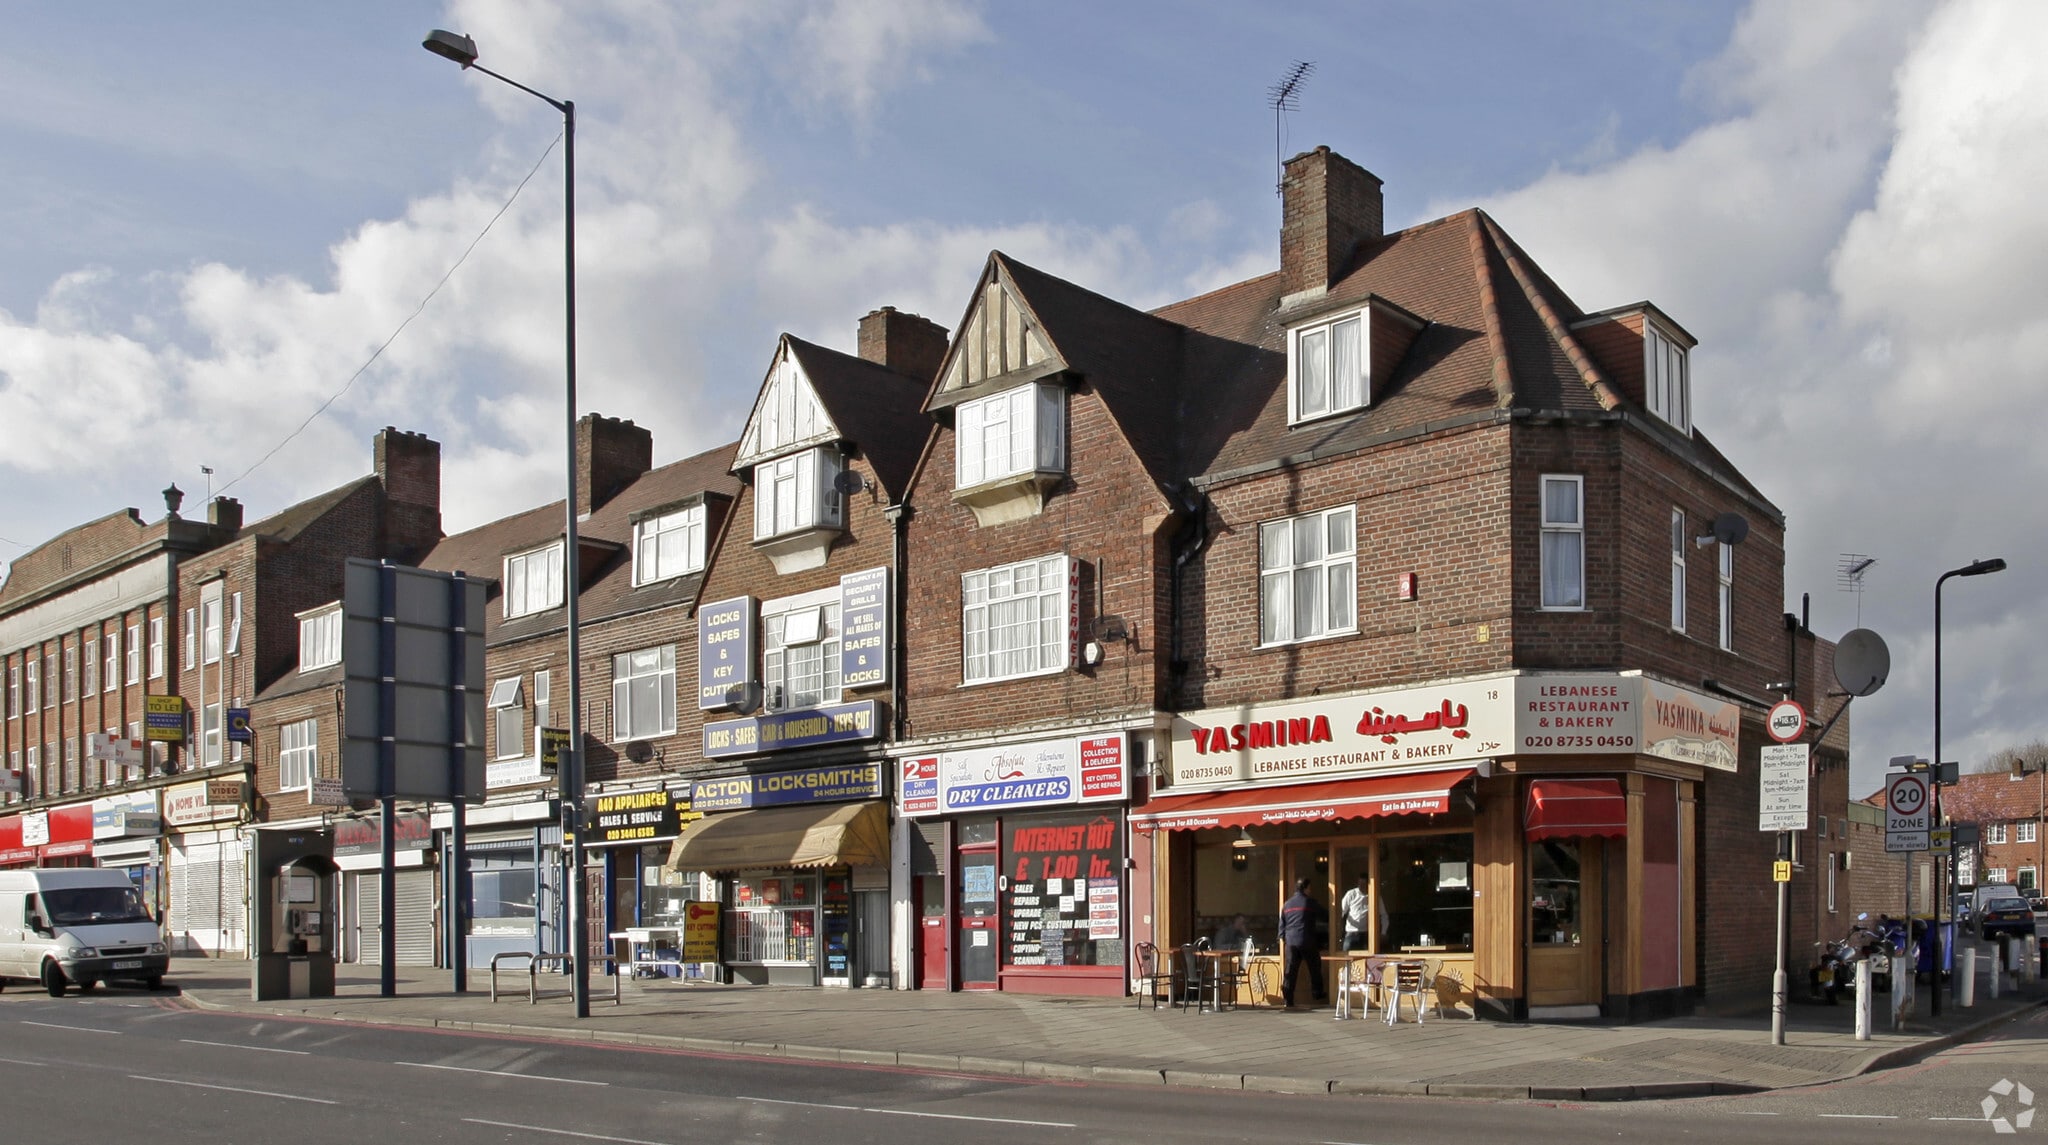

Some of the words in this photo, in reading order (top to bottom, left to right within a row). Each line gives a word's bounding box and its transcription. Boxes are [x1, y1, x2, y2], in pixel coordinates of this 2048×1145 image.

[845, 581, 882, 596] SECURITY
[850, 594, 876, 606] GRILLS
[707, 610, 740, 627] LOCKS
[853, 615, 862, 625] WE
[862, 613, 874, 623] SELL
[1069, 562, 1079, 666] INTERNET
[846, 626, 855, 635] ALL
[855, 622, 874, 633] MAKES
[874, 621, 882, 630] OF
[707, 628, 740, 644] SAFES
[845, 636, 881, 651] SAFES
[720, 649, 727, 660] &
[858, 655, 866, 665] &
[713, 665, 733, 679] KEY
[844, 669, 881, 684] LOCKS
[703, 681, 743, 698] CUTTING
[1487, 690, 1498, 700] 18
[1540, 686, 1618, 696] LEBANESE
[1528, 701, 1630, 712] RESTAURANT
[1539, 717, 1550, 727] &
[1555, 716, 1614, 727] BAKERY
[1656, 700, 1705, 735] YASMINA
[708, 730, 729, 749] LOCKS
[735, 726, 756, 745] SAFES
[762, 724, 776, 742] CAR
[777, 725, 783, 740] &
[784, 717, 828, 739] HOUSEHOLD
[834, 713, 853, 733] KEYS
[855, 710, 871, 730] CUT
[1191, 714, 1334, 756] YASMINA
[1092, 739, 1108, 747] FREE
[1525, 736, 1553, 747] 020
[1556, 736, 1593, 747] 8735
[1597, 736, 1633, 747] 0450
[1083, 747, 1119, 758] COLLECTION
[1254, 758, 1307, 774] LEBANESE
[1312, 750, 1385, 768] RESTAURANT
[1392, 748, 1400, 760] &
[1406, 743, 1454, 759] BAKERY
[1090, 757, 1117, 766] DELIVERY
[905, 761, 920, 780] 2
[921, 764, 936, 772] HOUR
[1180, 769, 1195, 780] 020
[1195, 767, 1212, 779] 8735
[1214, 765, 1233, 777] 0450
[695, 780, 752, 799] ACTON
[758, 767, 877, 792] LOCKSMITHS
[1096, 774, 1117, 782] CUTTING
[825, 788, 845, 796] HOUR
[846, 785, 879, 795] SERVICE
[905, 788, 936, 797] CLEANING
[948, 788, 981, 804] DRY
[982, 780, 1069, 801] CLEANERS
[1896, 788, 1920, 803] 20
[176, 796, 193, 810] HOME
[598, 797, 614, 812] A40
[614, 791, 668, 811] APPLIANCES
[694, 800, 706, 808] 020
[707, 799, 724, 807] 8743
[724, 797, 742, 806] 3405
[1382, 803, 1393, 811] Eat
[1393, 803, 1399, 811] In
[1407, 801, 1421, 809] Take
[1421, 800, 1440, 810] Away
[599, 815, 621, 827] SALES
[622, 814, 628, 824] &
[631, 810, 663, 824] SERVICE
[1891, 818, 1924, 829] ZONE
[607, 829, 620, 840] 020
[621, 828, 637, 839] 3441
[1013, 826, 1086, 853] INTERNET
[1087, 821, 1115, 849] HUT
[1014, 857, 1030, 881] £
[1041, 855, 1079, 880] 1.00
[1088, 854, 1113, 878] hr.
[1776, 864, 1788, 879] H
[1014, 884, 1034, 894] SALES
[1013, 896, 1040, 906] REPAIRS
[1013, 908, 1042, 918] UPGRADE
[1013, 921, 1029, 930] NEW
[1046, 920, 1073, 930] CUSTOM
[1013, 932, 1026, 942] FAX
[1013, 944, 1042, 953] COPYING
[1013, 956, 1046, 965] SCANNING
